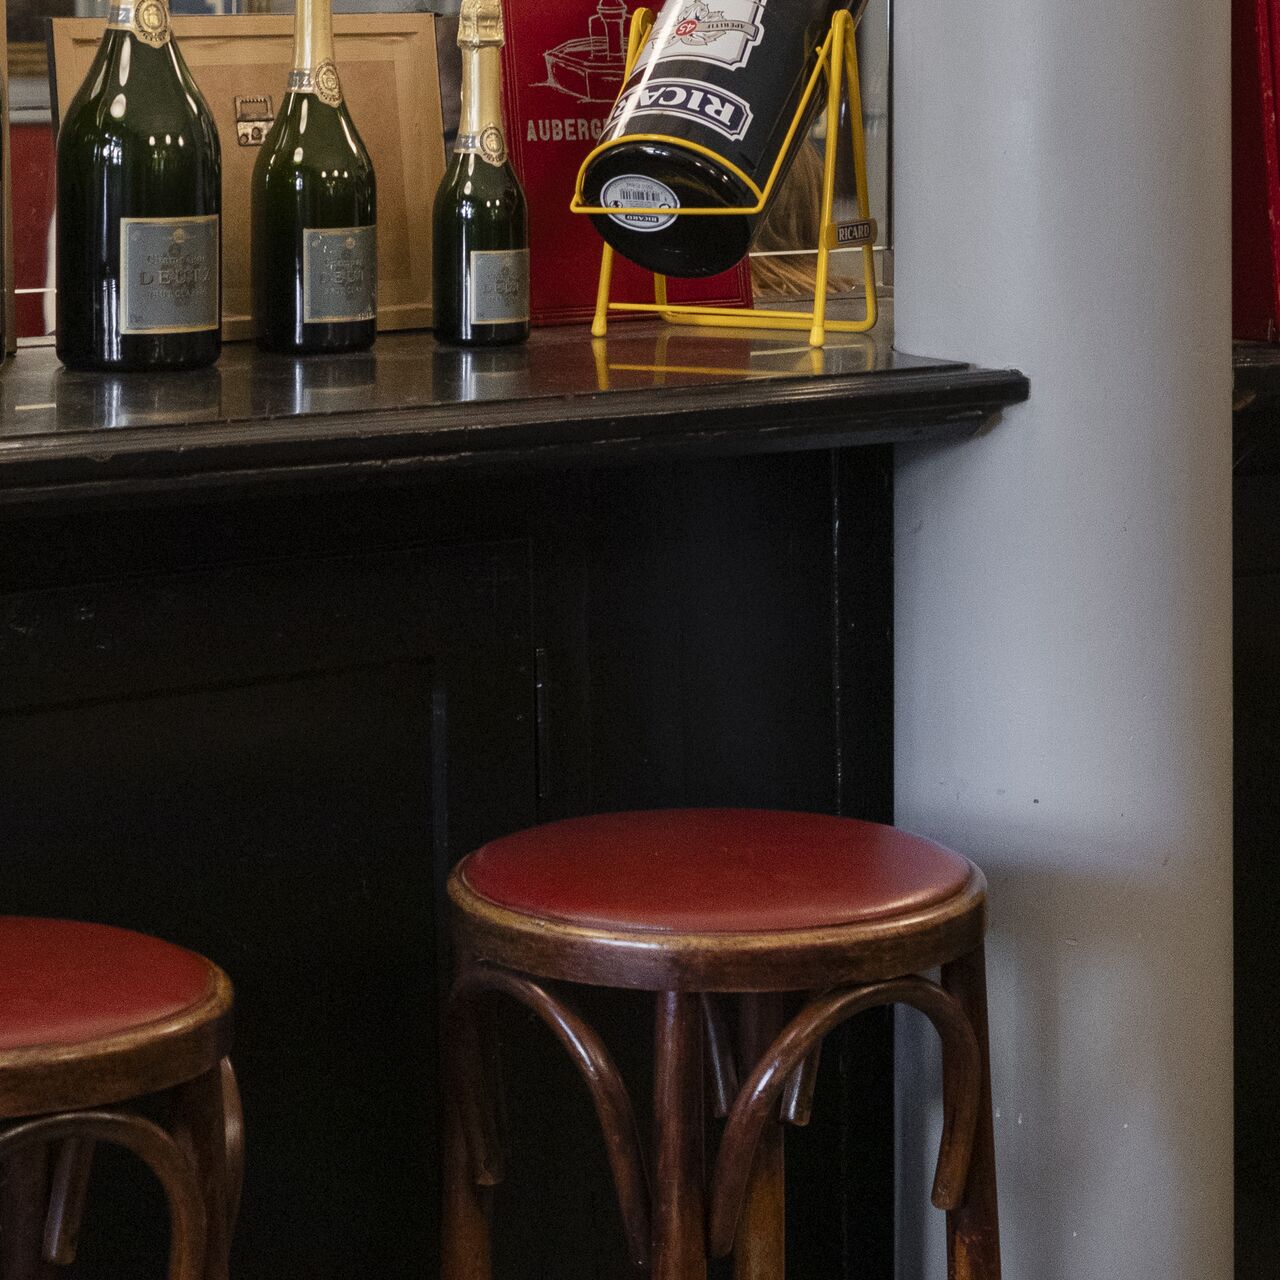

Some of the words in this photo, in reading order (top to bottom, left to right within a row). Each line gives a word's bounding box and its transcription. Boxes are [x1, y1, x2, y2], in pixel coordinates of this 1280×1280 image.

[679, 23, 697, 34] 45
[526, 117, 608, 142] AUBERG
[625, 214, 658, 223] RICARD
[838, 223, 870, 241] RICARD
